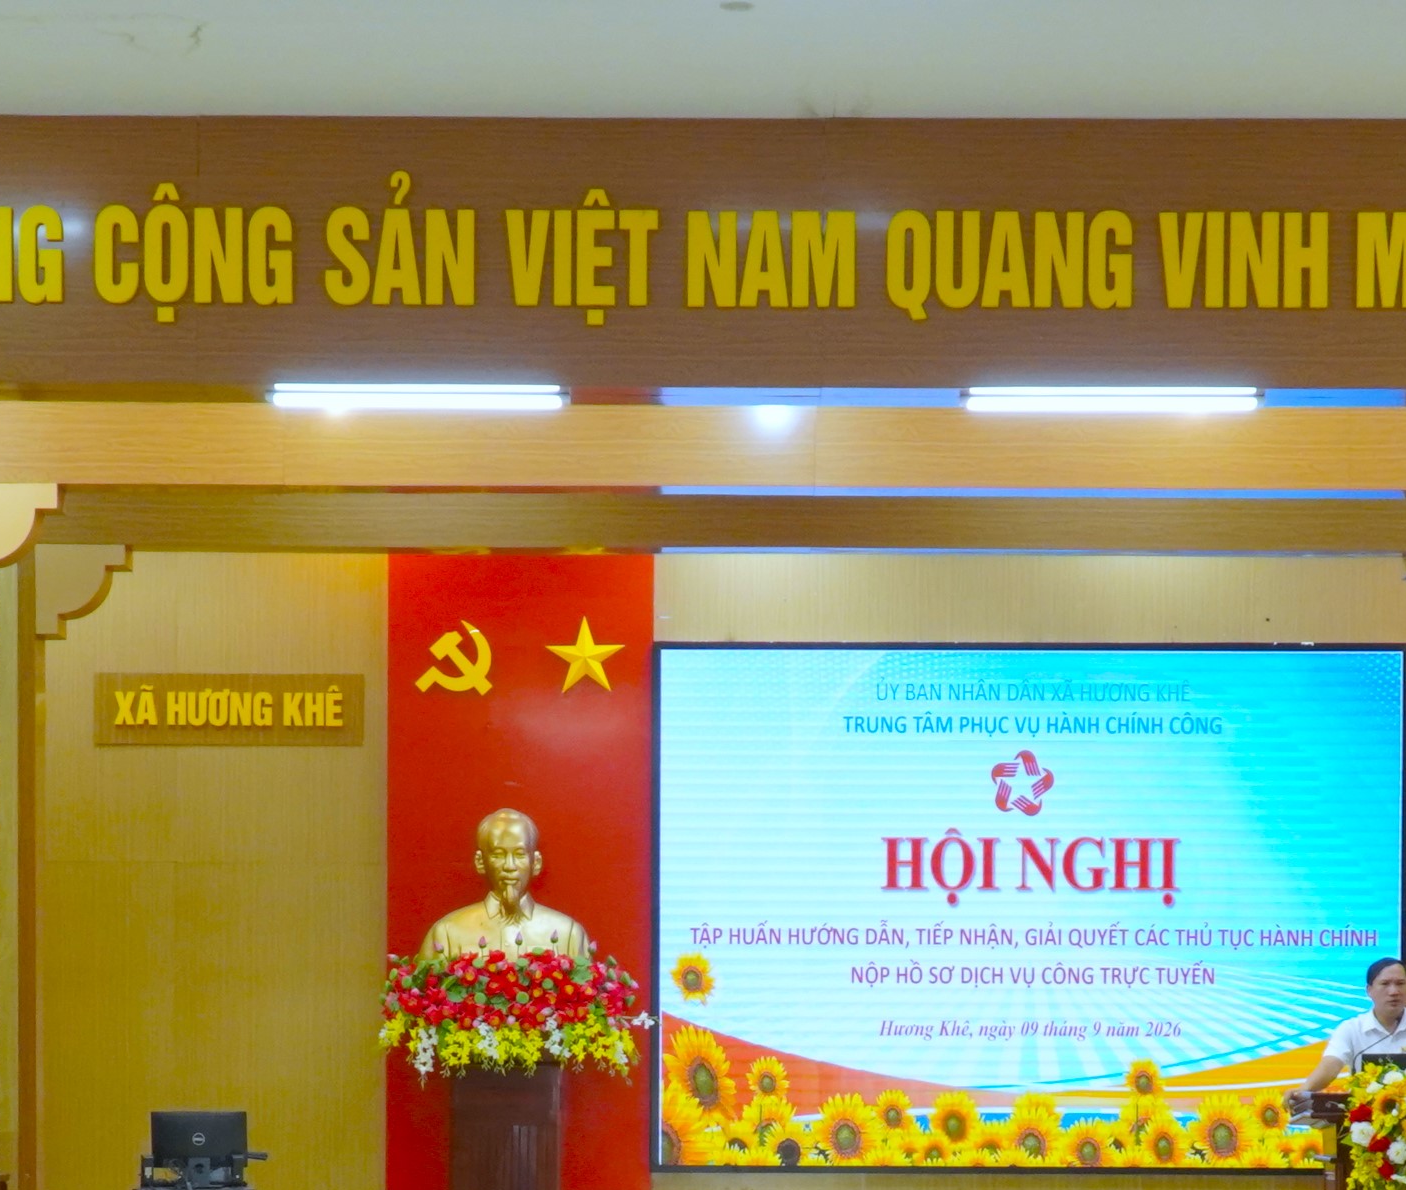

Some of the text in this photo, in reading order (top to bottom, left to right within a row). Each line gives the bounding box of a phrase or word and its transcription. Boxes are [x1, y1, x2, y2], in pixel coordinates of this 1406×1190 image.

[94, 182, 295, 323] CỘNG
[325, 169, 476, 307] SẢN
[504, 188, 660, 326] VIỆT
[686, 209, 857, 309] NAM
[886, 209, 1134, 322] QUANG
[1158, 210, 1330, 310] VINH
[876, 676, 1191, 702] ỦY BAN NHÂN DÂN XÃ HƯƠNG KHÊ
[113, 684, 344, 727] XÃ HƯƠNG KHÊ
[843, 711, 1223, 738] TRUNG TÂM PHỤC VỤ HÀNH CHÍNH CÔNG
[880, 827, 1181, 907] HỘI NGHỊ
[690, 919, 1378, 951] TẬP HUẤN HƯỚNG DẪN, TIẾP NHẬN, GIẢI QUYẾT CÁC THỦ TỤC HÀNH CHÍNH
[850, 959, 1215, 989] NỘP HỒ SƠ DỊCH VỤ CÔNG TRỰC TUYẾN
[879, 1020, 1182, 1041] Hương Khê, ngày 09 tháng 9 năm 2026
